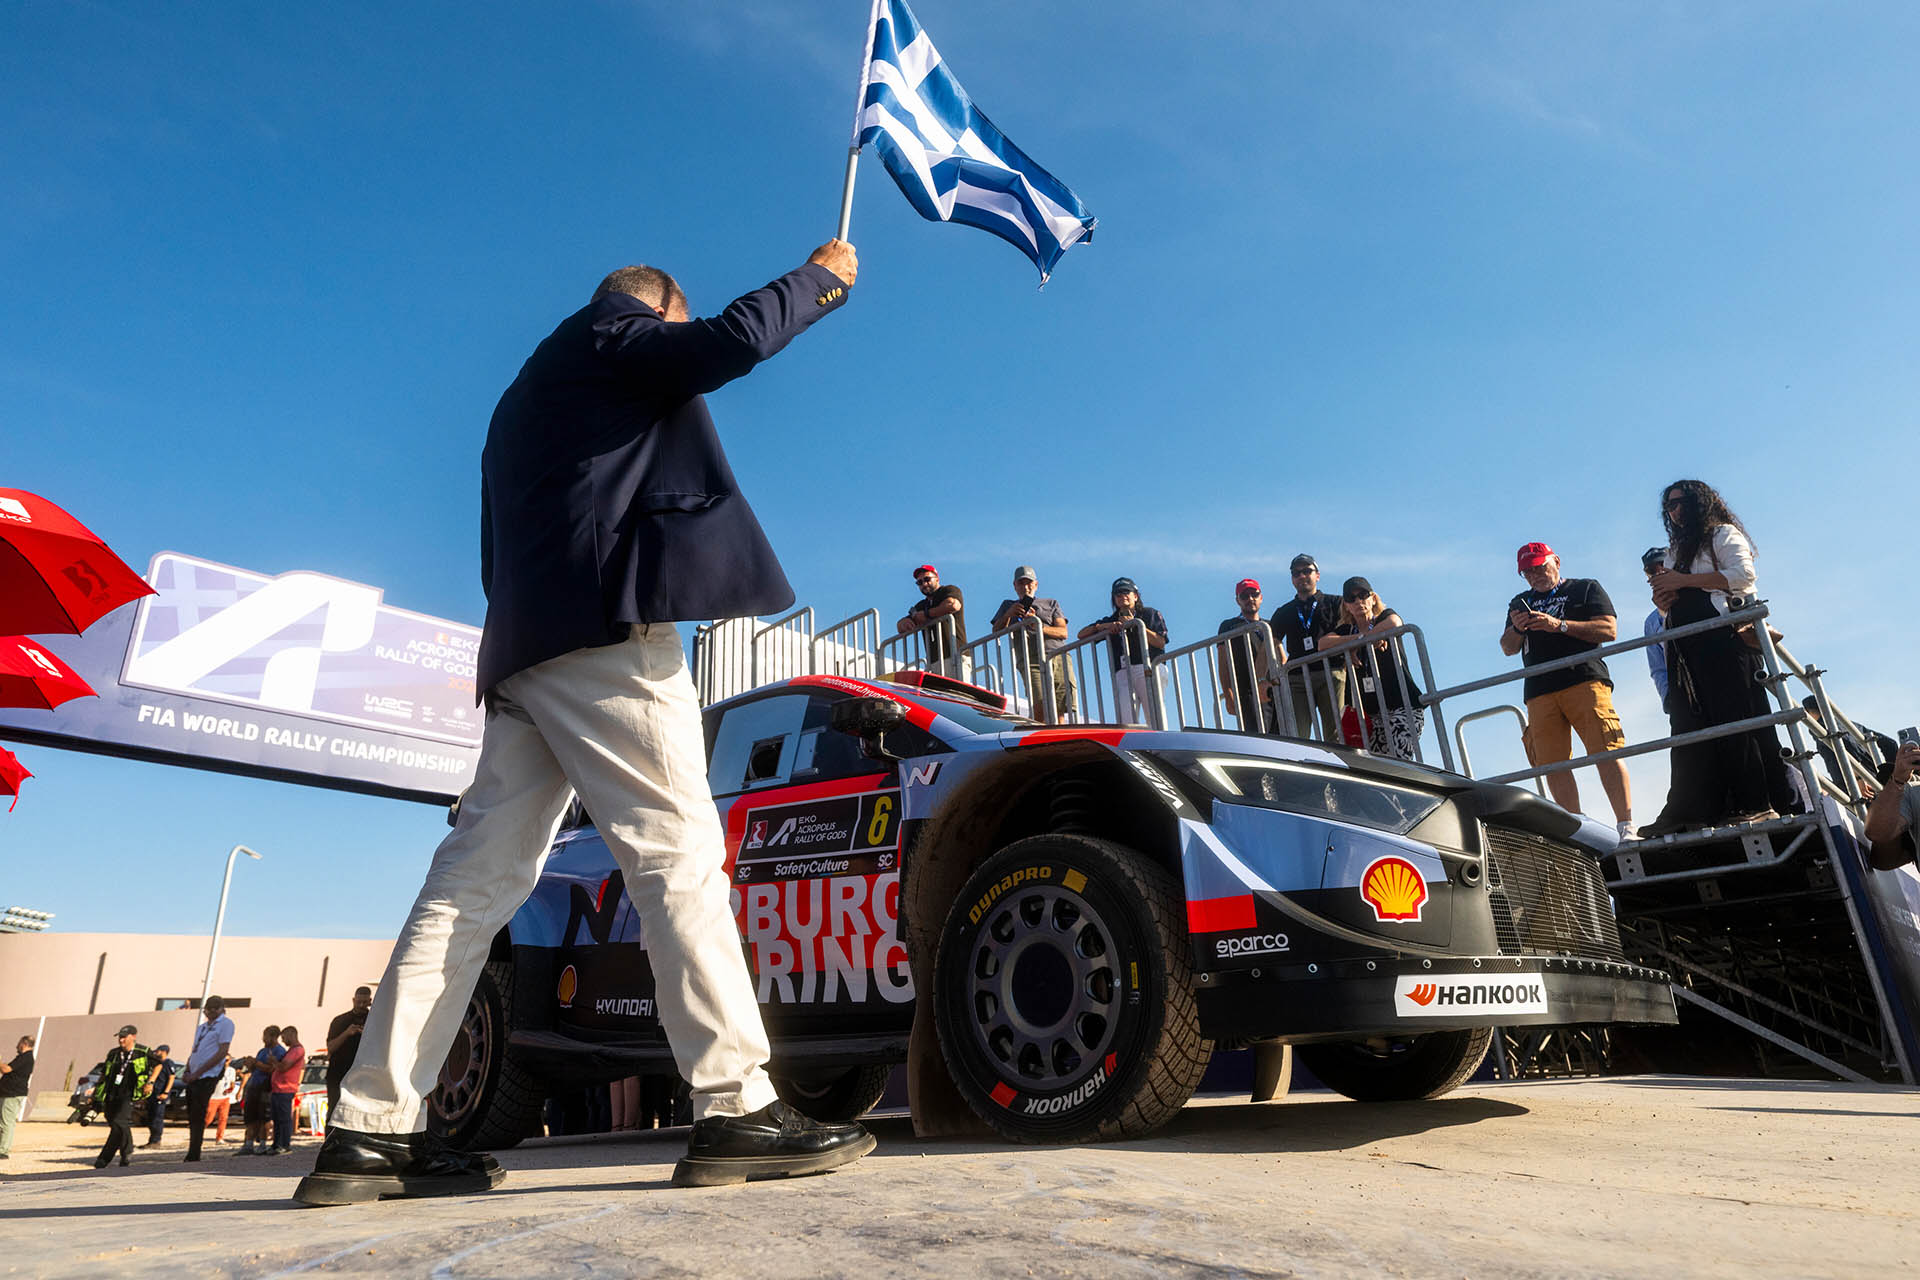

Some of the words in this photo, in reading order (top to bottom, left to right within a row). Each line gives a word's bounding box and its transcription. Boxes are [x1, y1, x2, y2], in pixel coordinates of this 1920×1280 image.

[375, 645, 420, 665] RALLY
[421, 656, 442, 670] OF
[443, 661, 475, 678] GOD
[407, 639, 477, 665] ACROPOLI
[138, 704, 175, 728] FIA
[183, 711, 260, 742] WORLD
[264, 726, 327, 753] RALLY
[330, 738, 467, 774] CHAMPIONSHIP
[796, 822, 836, 835] ACROPOLIS
[798, 815, 817, 824] EKO
[867, 796, 893, 846] 6
[794, 834, 816, 845] RALLY
[816, 833, 827, 842] OF
[827, 830, 848, 840] GODS
[774, 859, 849, 878] SafetyCulture
[877, 853, 893, 868] SC
[738, 867, 751, 879] SC
[1216, 933, 1289, 958] sparco
[757, 932, 916, 1004] RING
[596, 999, 653, 1017] HYUNDAI
